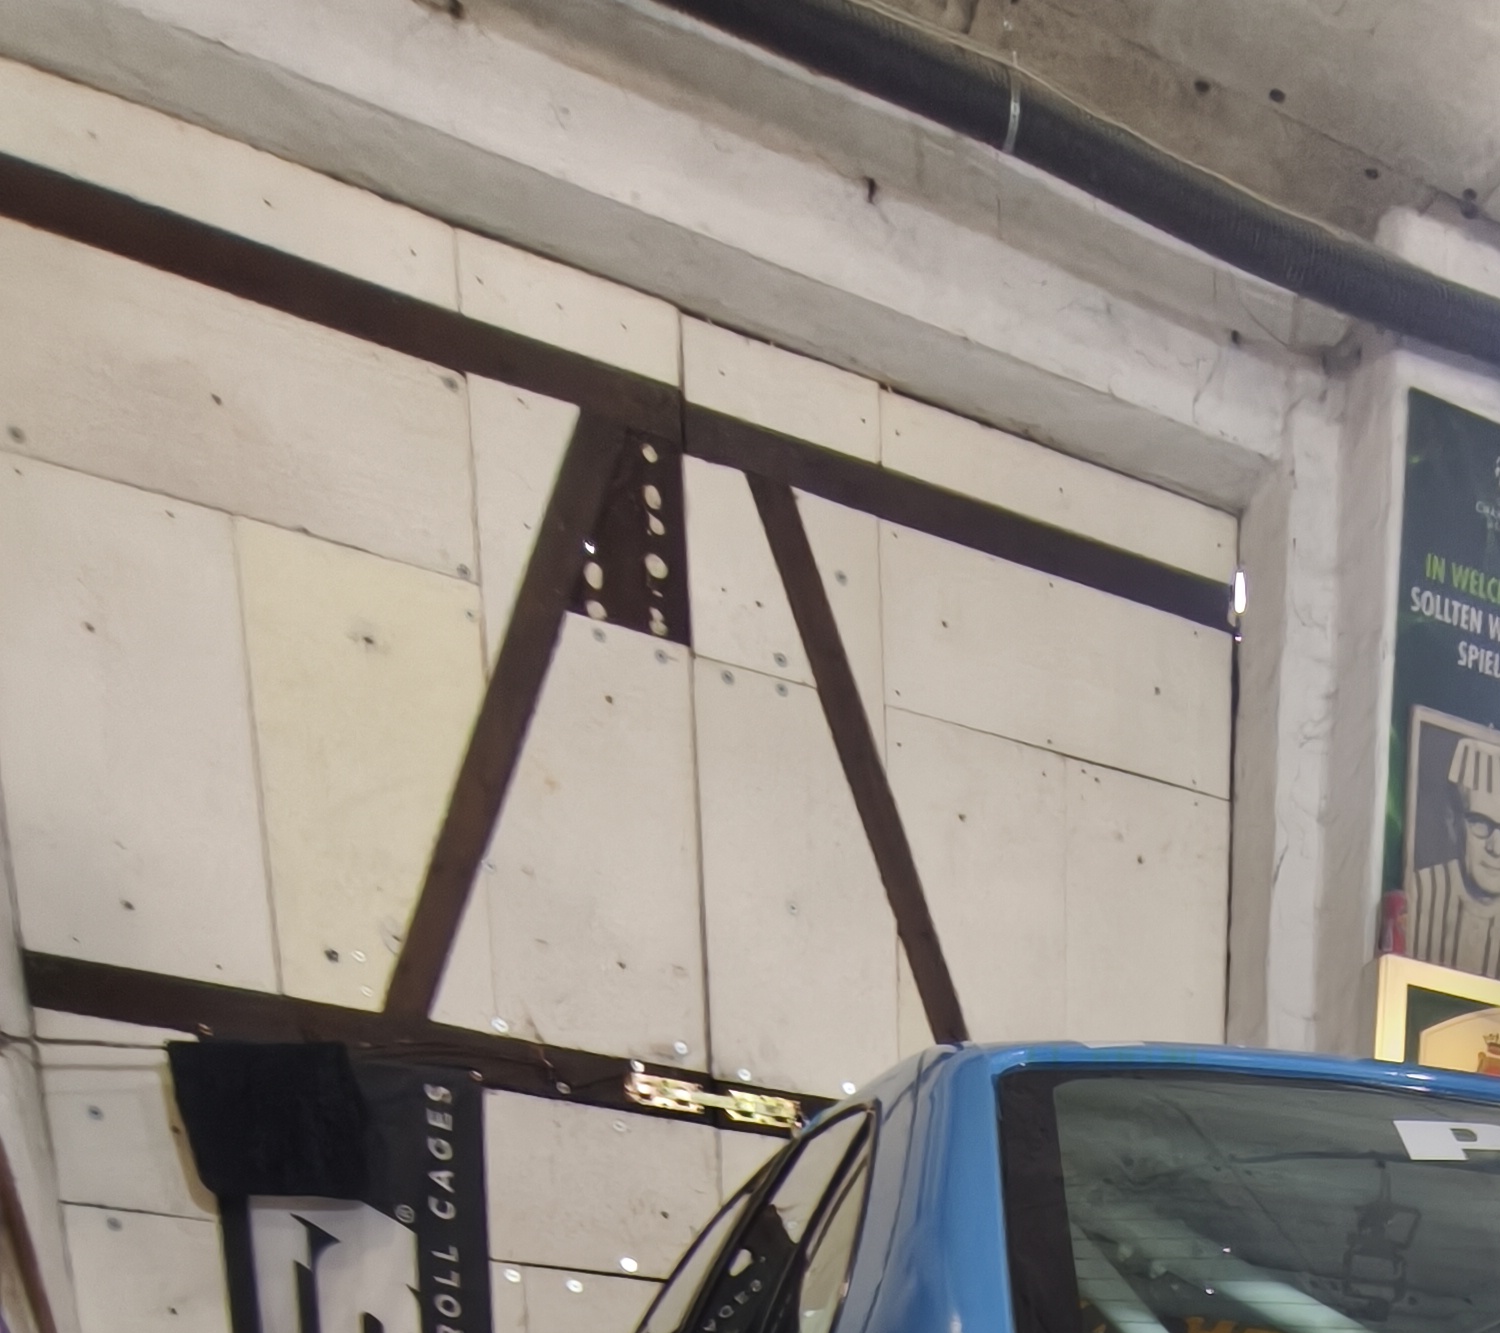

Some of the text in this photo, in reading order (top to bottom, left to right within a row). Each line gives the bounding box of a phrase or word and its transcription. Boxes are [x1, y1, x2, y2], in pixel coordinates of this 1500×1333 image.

[1425, 553, 1446, 583] IN
[1410, 586, 1483, 634] SOLLTEN
[423, 1083, 457, 1221] CAGES
